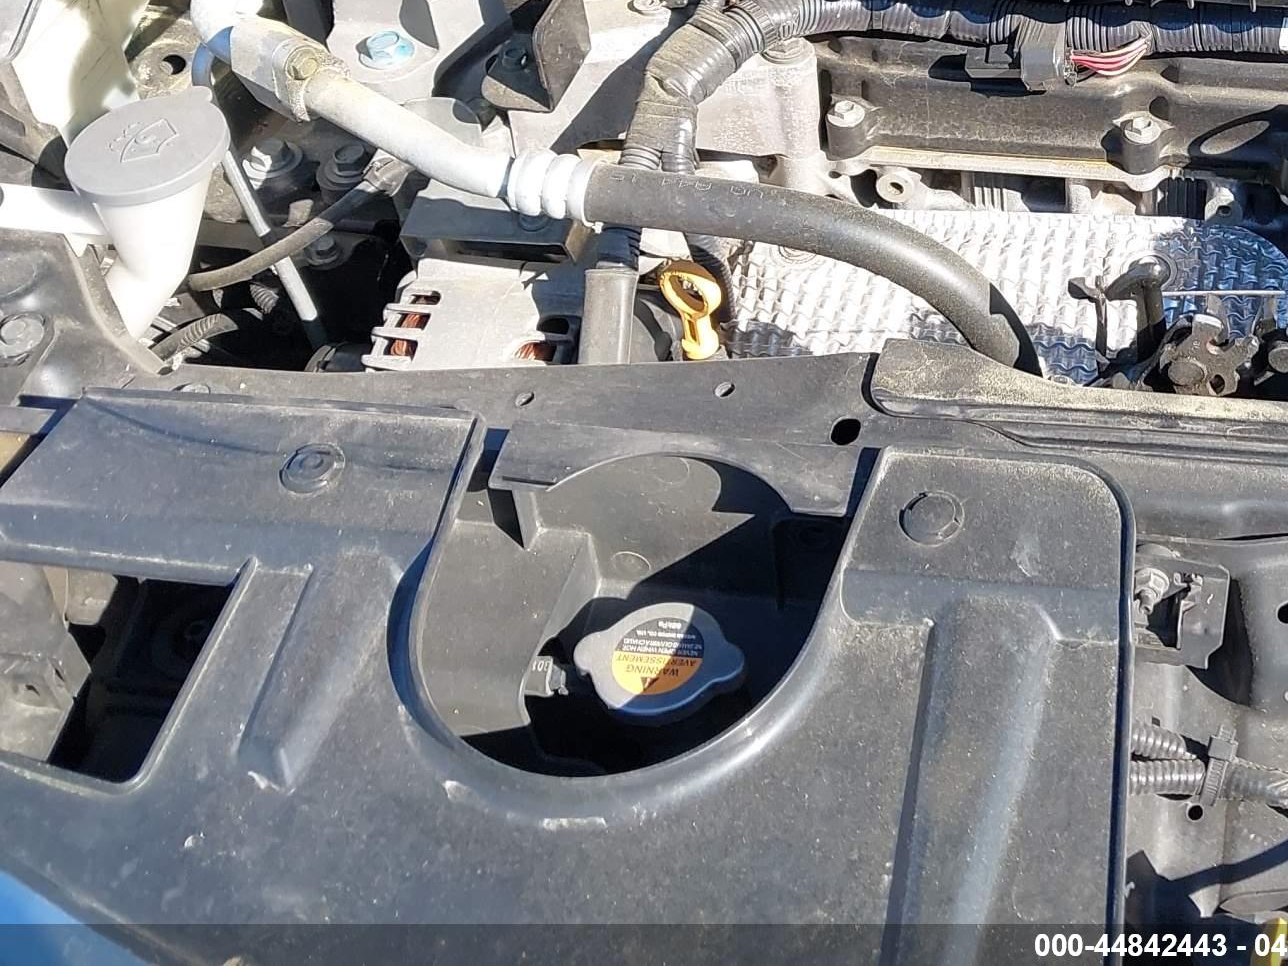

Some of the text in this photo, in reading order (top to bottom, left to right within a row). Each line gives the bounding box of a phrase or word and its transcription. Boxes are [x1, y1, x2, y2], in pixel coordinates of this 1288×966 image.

[637, 645, 658, 653] WHEN
[615, 653, 697, 667] AVERTISSEMENT
[624, 663, 679, 677] WARNING
